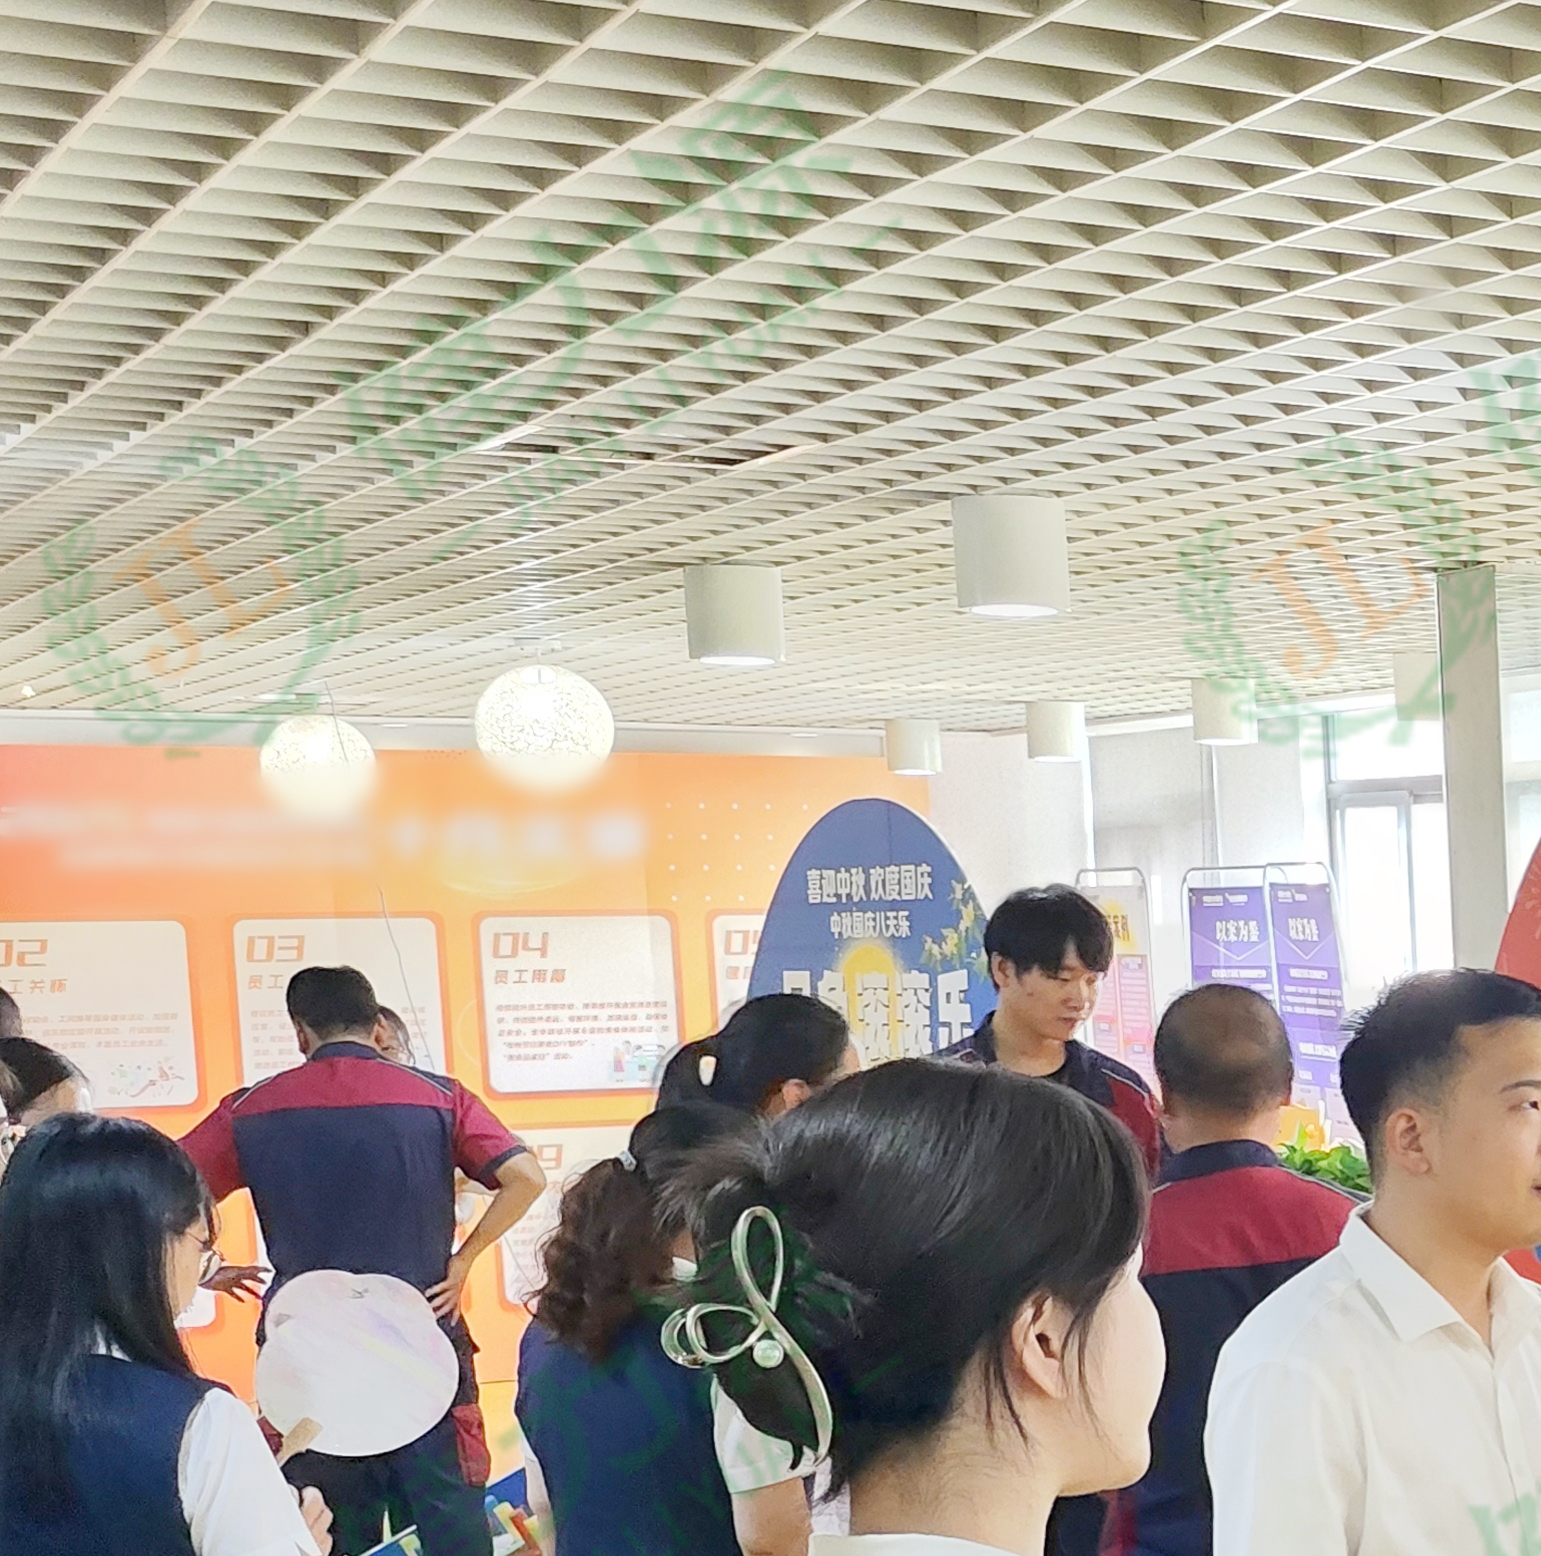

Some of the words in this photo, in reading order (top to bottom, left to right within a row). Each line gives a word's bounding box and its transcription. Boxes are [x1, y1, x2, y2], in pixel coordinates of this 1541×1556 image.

[806, 867, 866, 904] 喜迎中秋
[870, 863, 933, 902] 欢度国庆
[830, 911, 911, 939] 中秋国庆八天乐
[246, 935, 305, 963] 03
[492, 931, 549, 959] 04
[783, 968, 974, 1065] 滚滚乐
